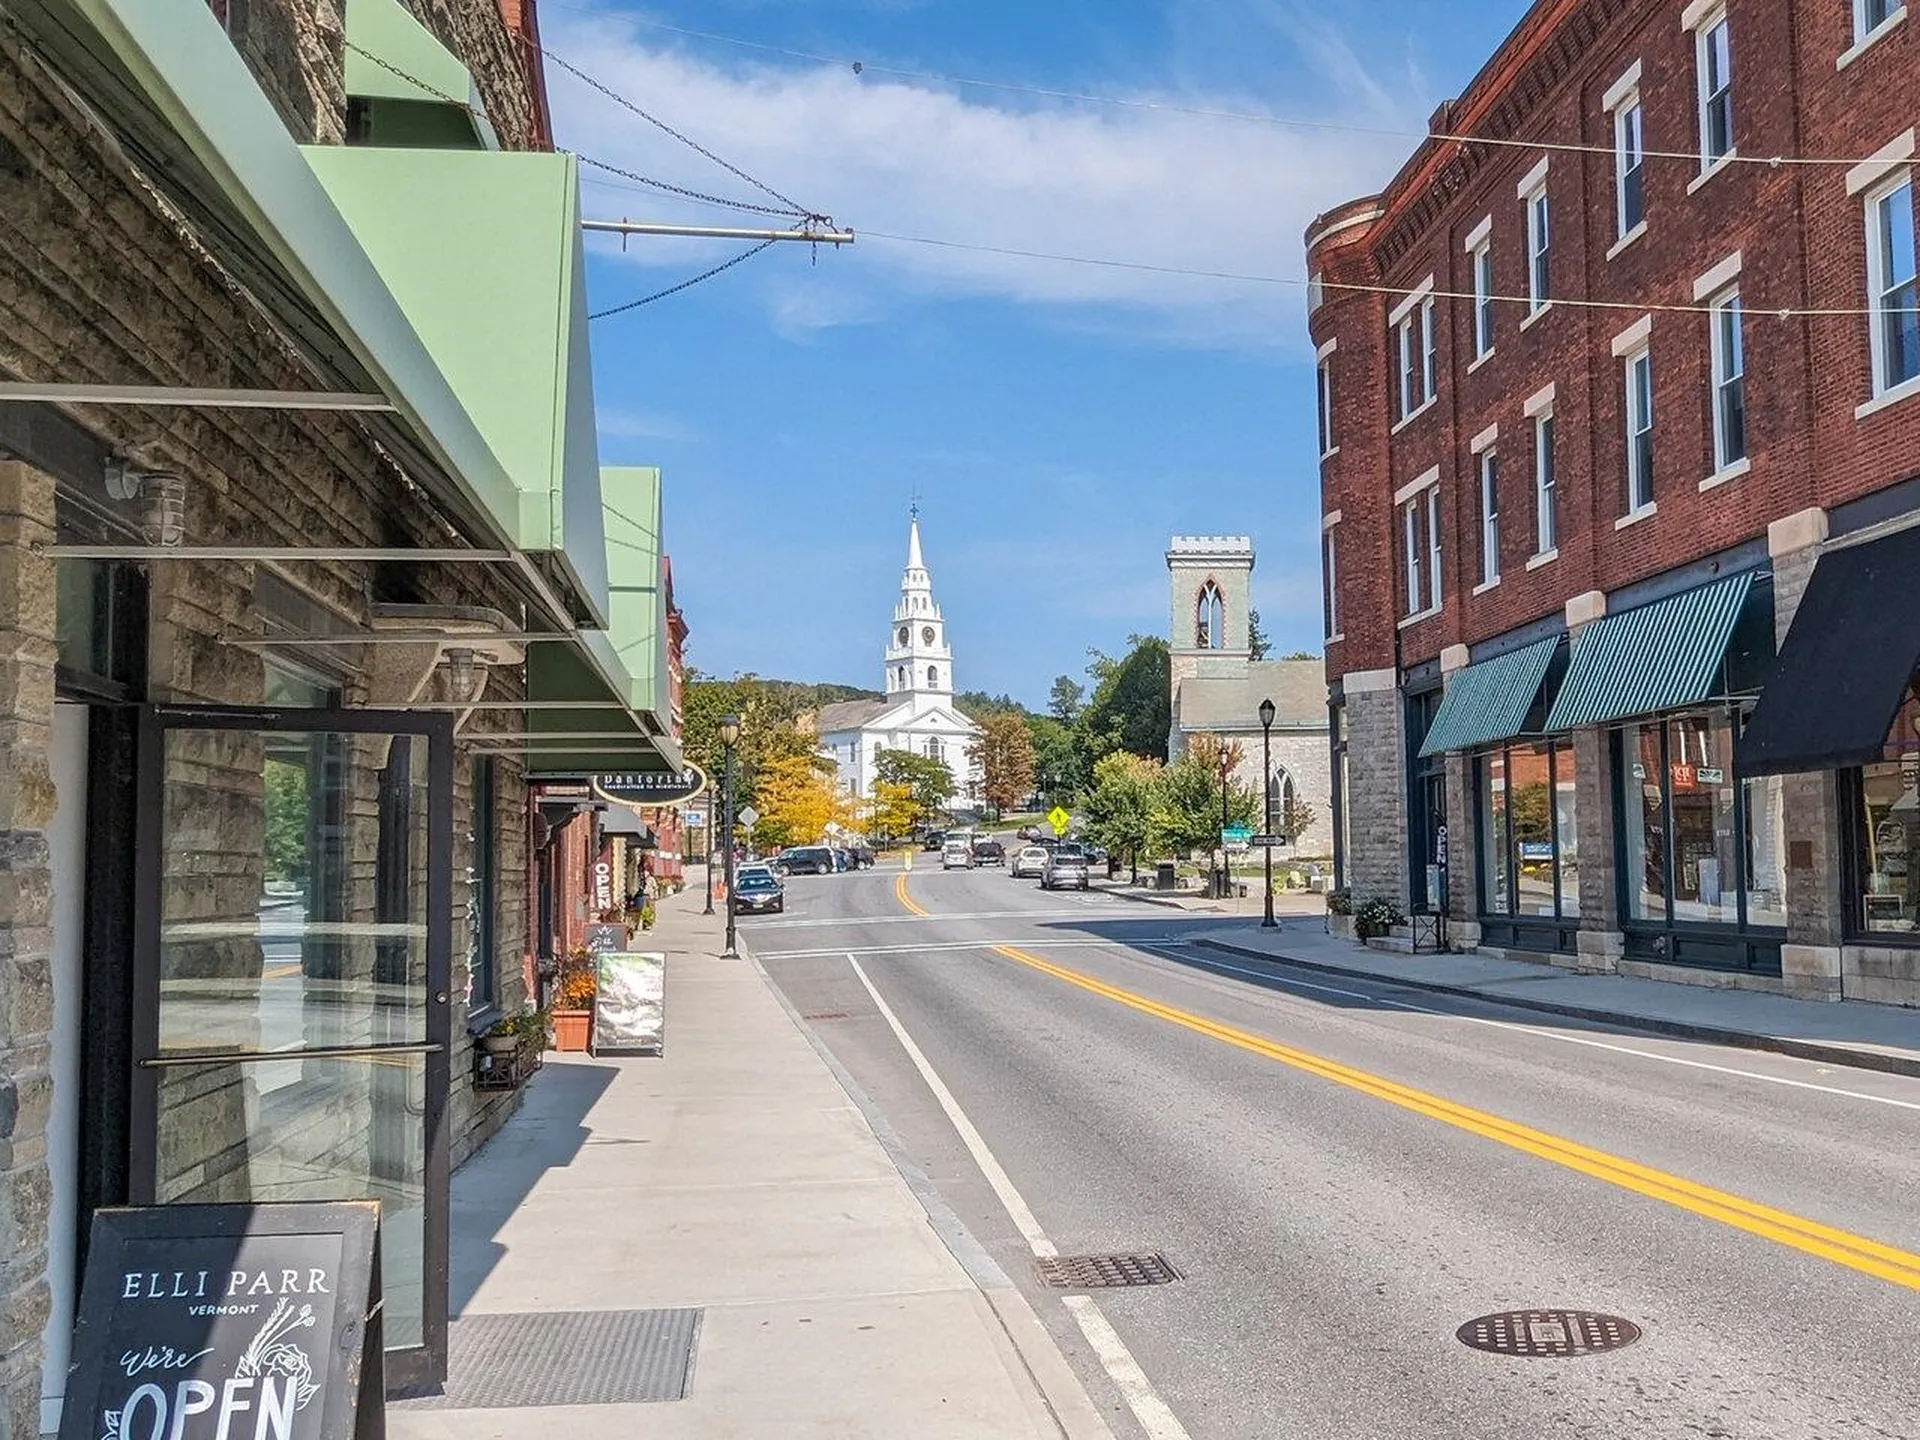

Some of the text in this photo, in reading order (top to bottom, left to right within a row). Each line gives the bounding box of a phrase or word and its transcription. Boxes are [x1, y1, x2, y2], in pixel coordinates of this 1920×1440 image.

[1437, 826, 1447, 863] OPEN
[595, 862, 611, 909] OPEN
[122, 1268, 330, 1298] ELLI PARR
[188, 1304, 260, 1316] VERMONT
